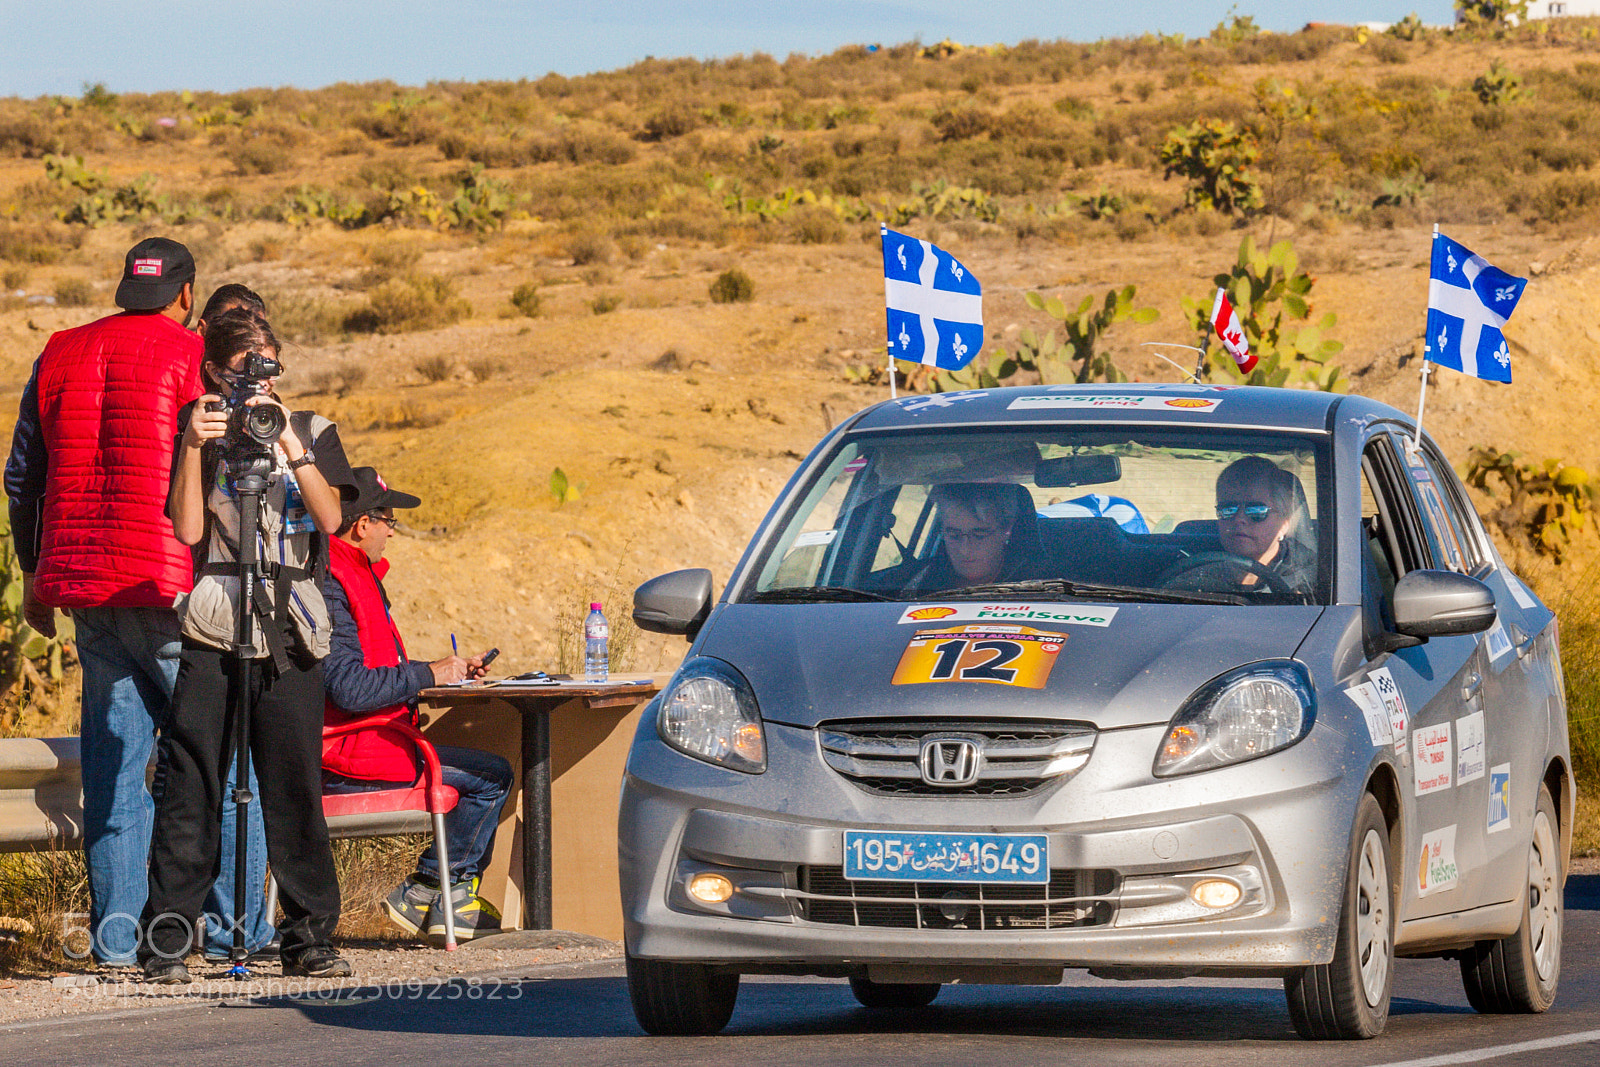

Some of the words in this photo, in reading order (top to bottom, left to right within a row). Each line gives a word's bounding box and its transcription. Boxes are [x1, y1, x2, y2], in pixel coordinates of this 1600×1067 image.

[977, 610, 1106, 624] FuelSave
[930, 638, 1024, 683] 12
[853, 838, 903, 872] 195
[969, 841, 1040, 875] 1649
[1430, 857, 1458, 885] FuelSave
